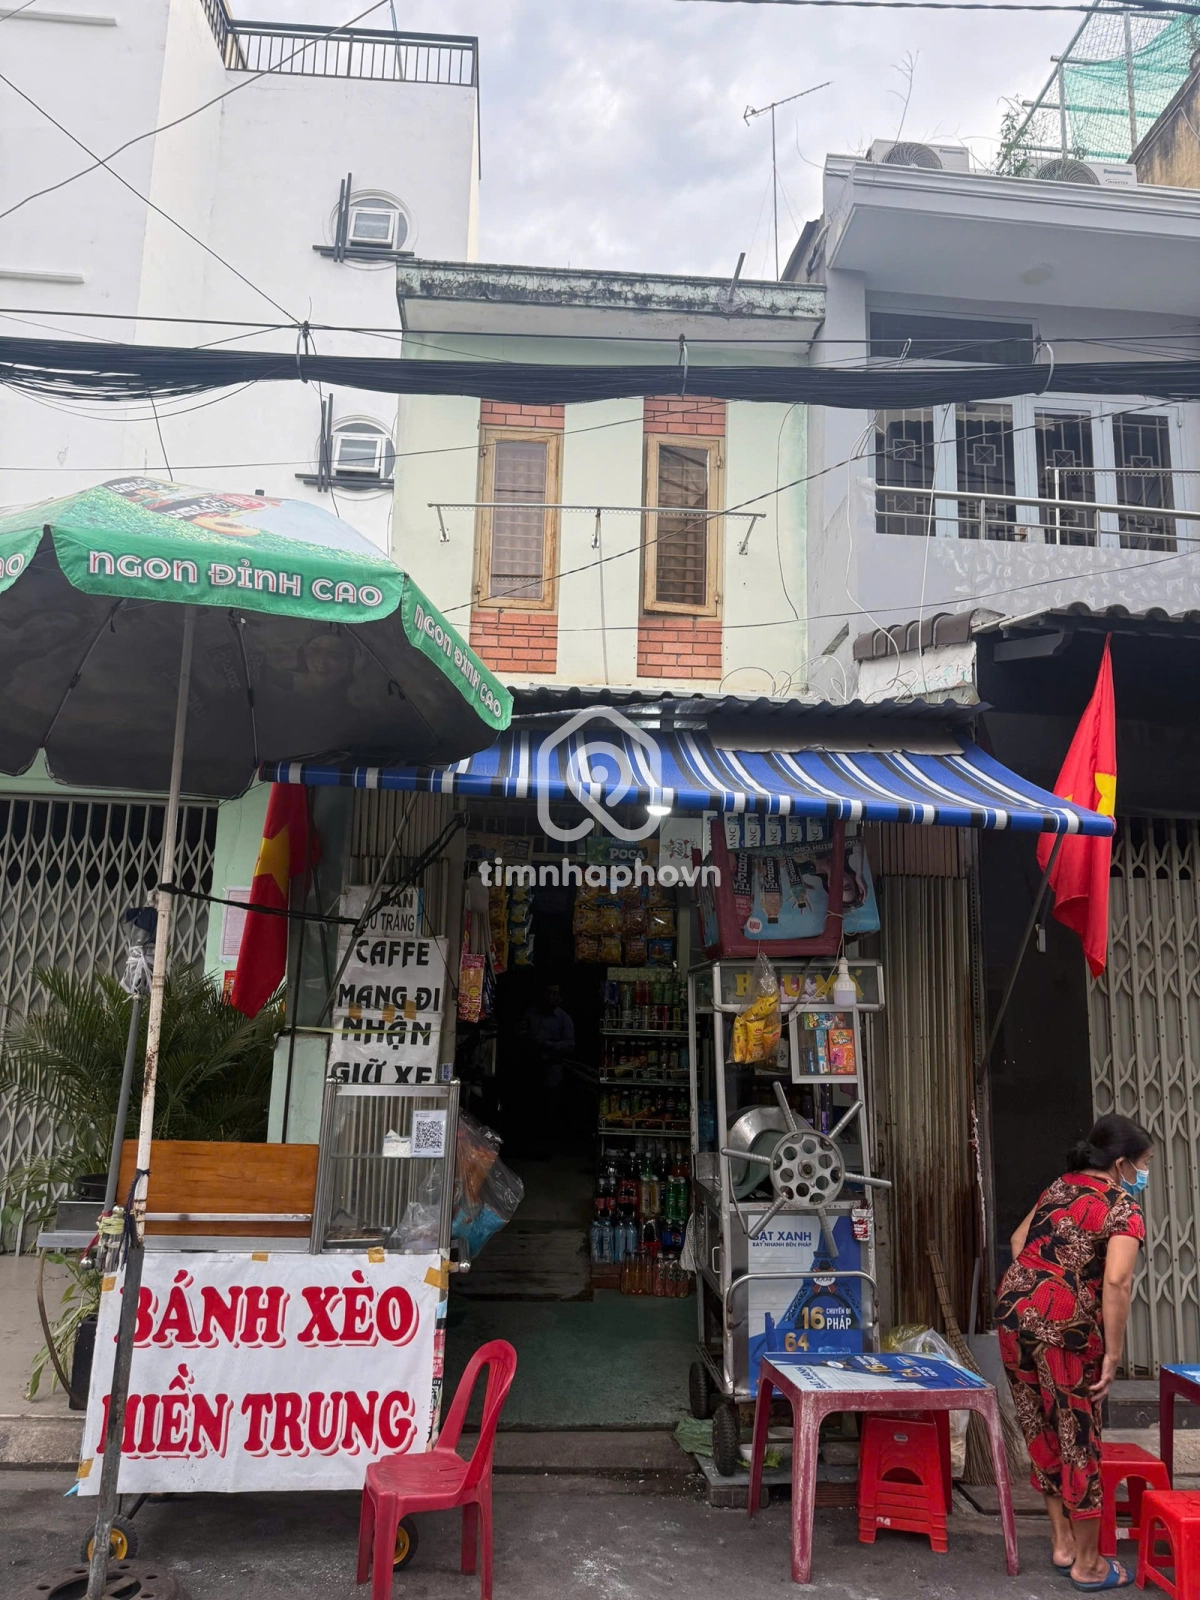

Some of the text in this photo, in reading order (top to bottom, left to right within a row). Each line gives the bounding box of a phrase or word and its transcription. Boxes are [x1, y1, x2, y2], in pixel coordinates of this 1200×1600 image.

[0, 554, 24, 578] O
[88, 550, 383, 607] NGON ĐỈNH CAO
[414, 603, 501, 717] NGON ĐỈNH CAO
[608, 848, 646, 860] POCA
[356, 940, 430, 968] CAFFE
[338, 984, 440, 1011] MANG ĐI
[341, 1015, 432, 1050] NHẬN
[331, 1058, 387, 1083] GIỮ
[395, 1065, 432, 1084] XE
[777, 1232, 812, 1241] XANH
[114, 1269, 420, 1348] BÁNH XÈO
[801, 1306, 825, 1330] 16
[826, 1315, 852, 1330] PHÁP
[785, 1332, 810, 1352] 64
[241, 1390, 418, 1458] TRUNG
